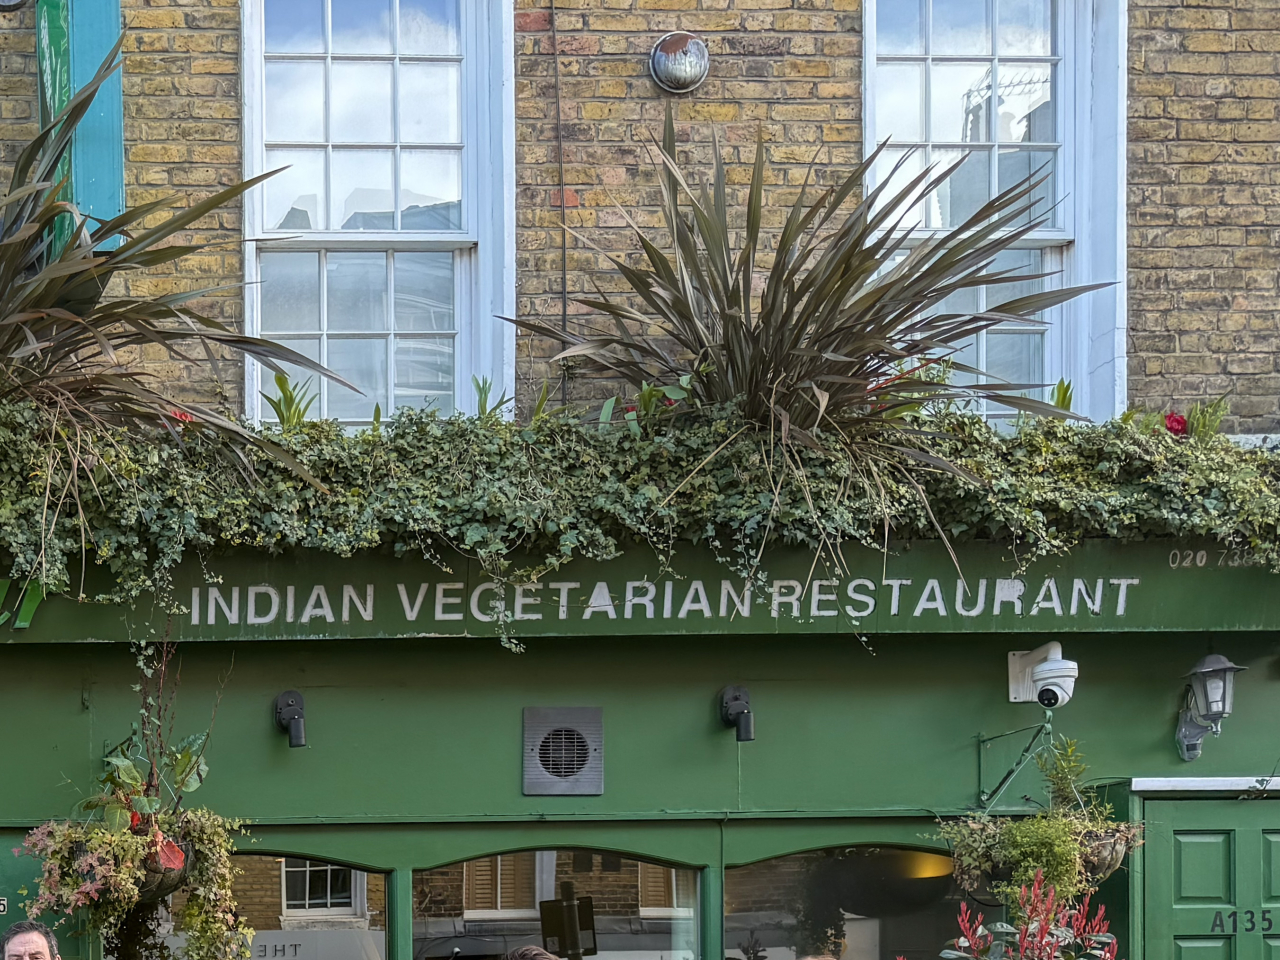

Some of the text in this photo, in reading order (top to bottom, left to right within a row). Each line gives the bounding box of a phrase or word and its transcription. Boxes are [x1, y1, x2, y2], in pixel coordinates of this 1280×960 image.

[1169, 548, 1207, 569] 020
[190, 577, 1140, 626] INDIAN VEGETARIAN RESTAURANT
[1211, 909, 1273, 933] A135
